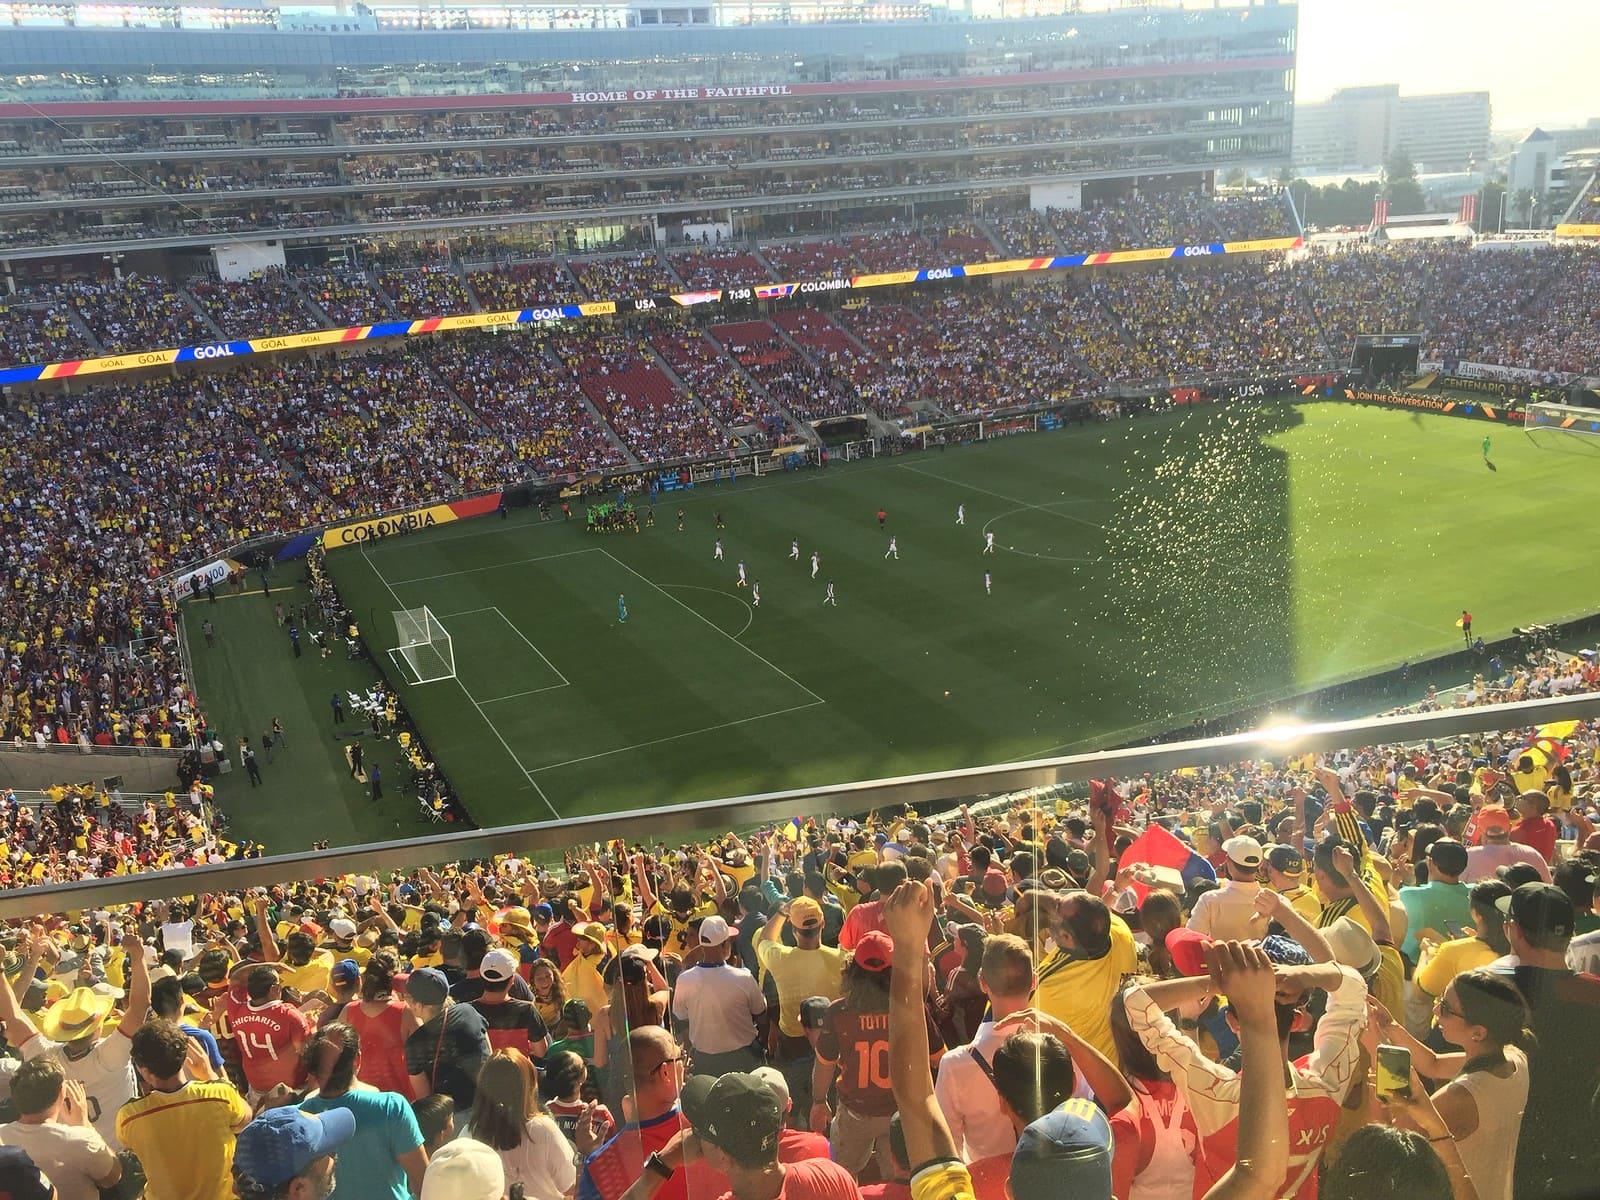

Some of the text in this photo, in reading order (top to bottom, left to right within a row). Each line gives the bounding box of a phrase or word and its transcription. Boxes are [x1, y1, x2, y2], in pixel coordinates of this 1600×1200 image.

[571, 85, 792, 102] HOME OF THE FAITHFUL
[1184, 245, 1211, 257] GOAL
[927, 268, 953, 280] GOAL
[800, 278, 851, 294] COLOMBIA
[728, 288, 751, 300] 7:30
[588, 304, 612, 314] GOAL
[634, 298, 656, 311] USA
[487, 313, 512, 324] GOAL
[532, 307, 565, 321] GOAL
[456, 317, 475, 326] GOAL
[261, 338, 288, 350] GOAL
[300, 334, 321, 344] GOAL
[193, 343, 234, 360] GOAL
[100, 358, 125, 369] GOAL
[137, 352, 169, 366] GOAL
[1238, 385, 1265, 398] USA
[1444, 377, 1506, 395] CENTENARIO
[1356, 391, 1443, 409] JOIN THE CONVERSATION
[341, 511, 436, 545] COOMBIA
[176, 566, 225, 595] #CPA100
[859, 1014, 889, 1031] TOTT
[237, 1029, 279, 1061] 14
[854, 1039, 894, 1089] 10
[1295, 1124, 1330, 1146] XIS
